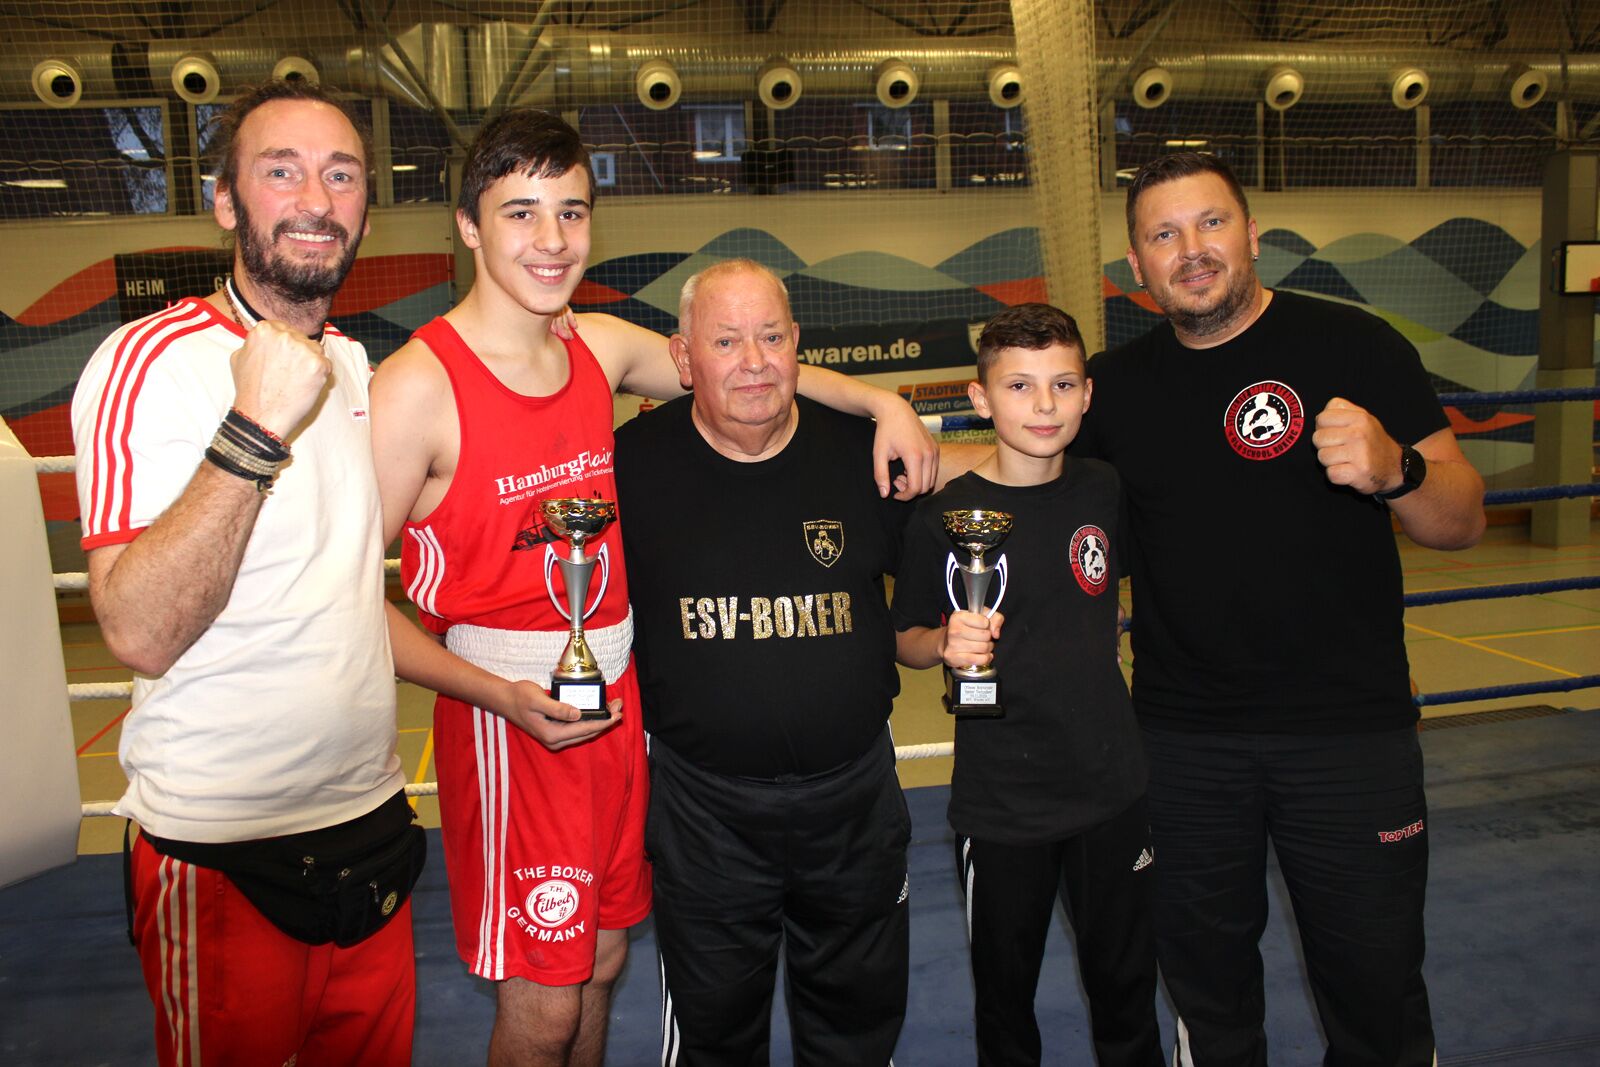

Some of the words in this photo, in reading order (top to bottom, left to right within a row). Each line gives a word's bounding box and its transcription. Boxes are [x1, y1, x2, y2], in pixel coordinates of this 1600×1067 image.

[125, 279, 165, 297] HEIM
[915, 383, 968, 398] STADTWE
[914, 400, 951, 413] Waren
[500, 493, 525, 506] Agentur
[679, 591, 853, 640] ESV-BOXER
[513, 865, 547, 881] THE
[550, 865, 594, 887] BOXER
[507, 906, 586, 943] GERMANY
